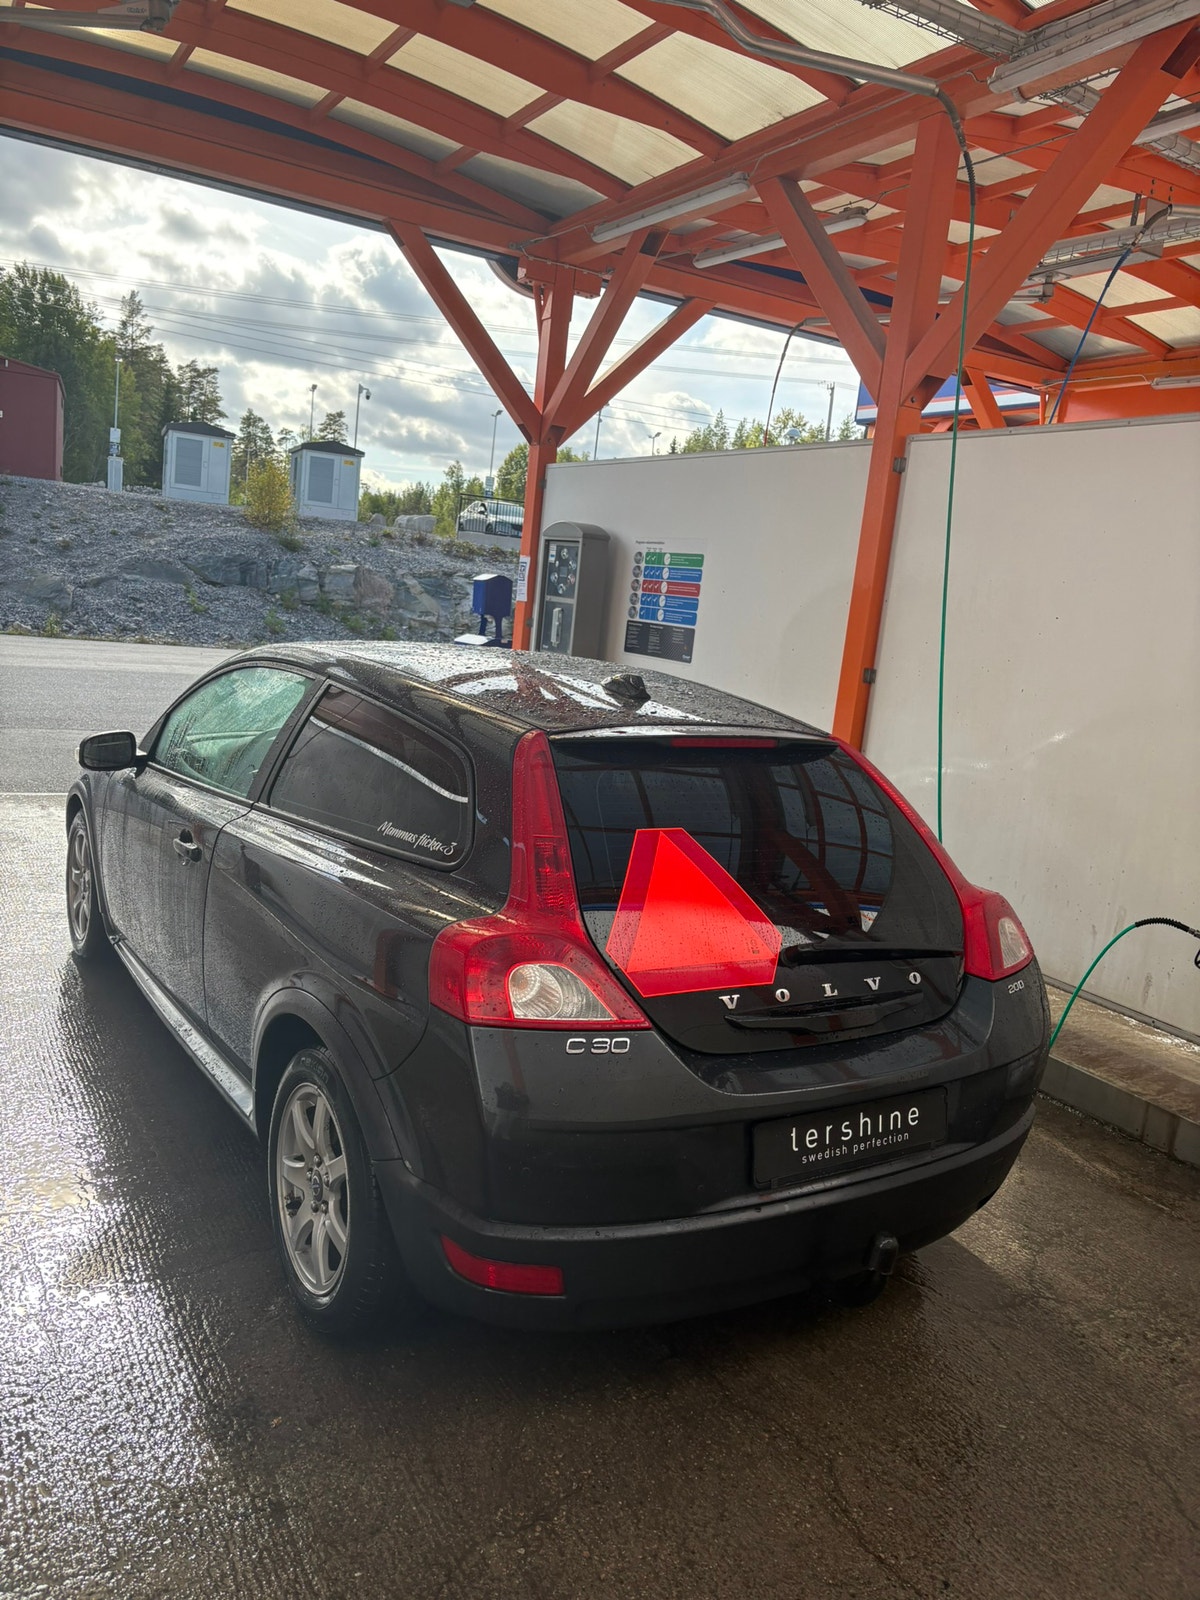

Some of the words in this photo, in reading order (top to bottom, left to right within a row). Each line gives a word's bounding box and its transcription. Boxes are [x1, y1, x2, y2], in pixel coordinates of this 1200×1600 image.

[377, 821, 418, 843] Mammas
[719, 971, 922, 1010] VOLVO
[790, 1107, 919, 1152] tershine
[801, 1144, 848, 1164] swedish
[853, 1132, 910, 1155] perfection
